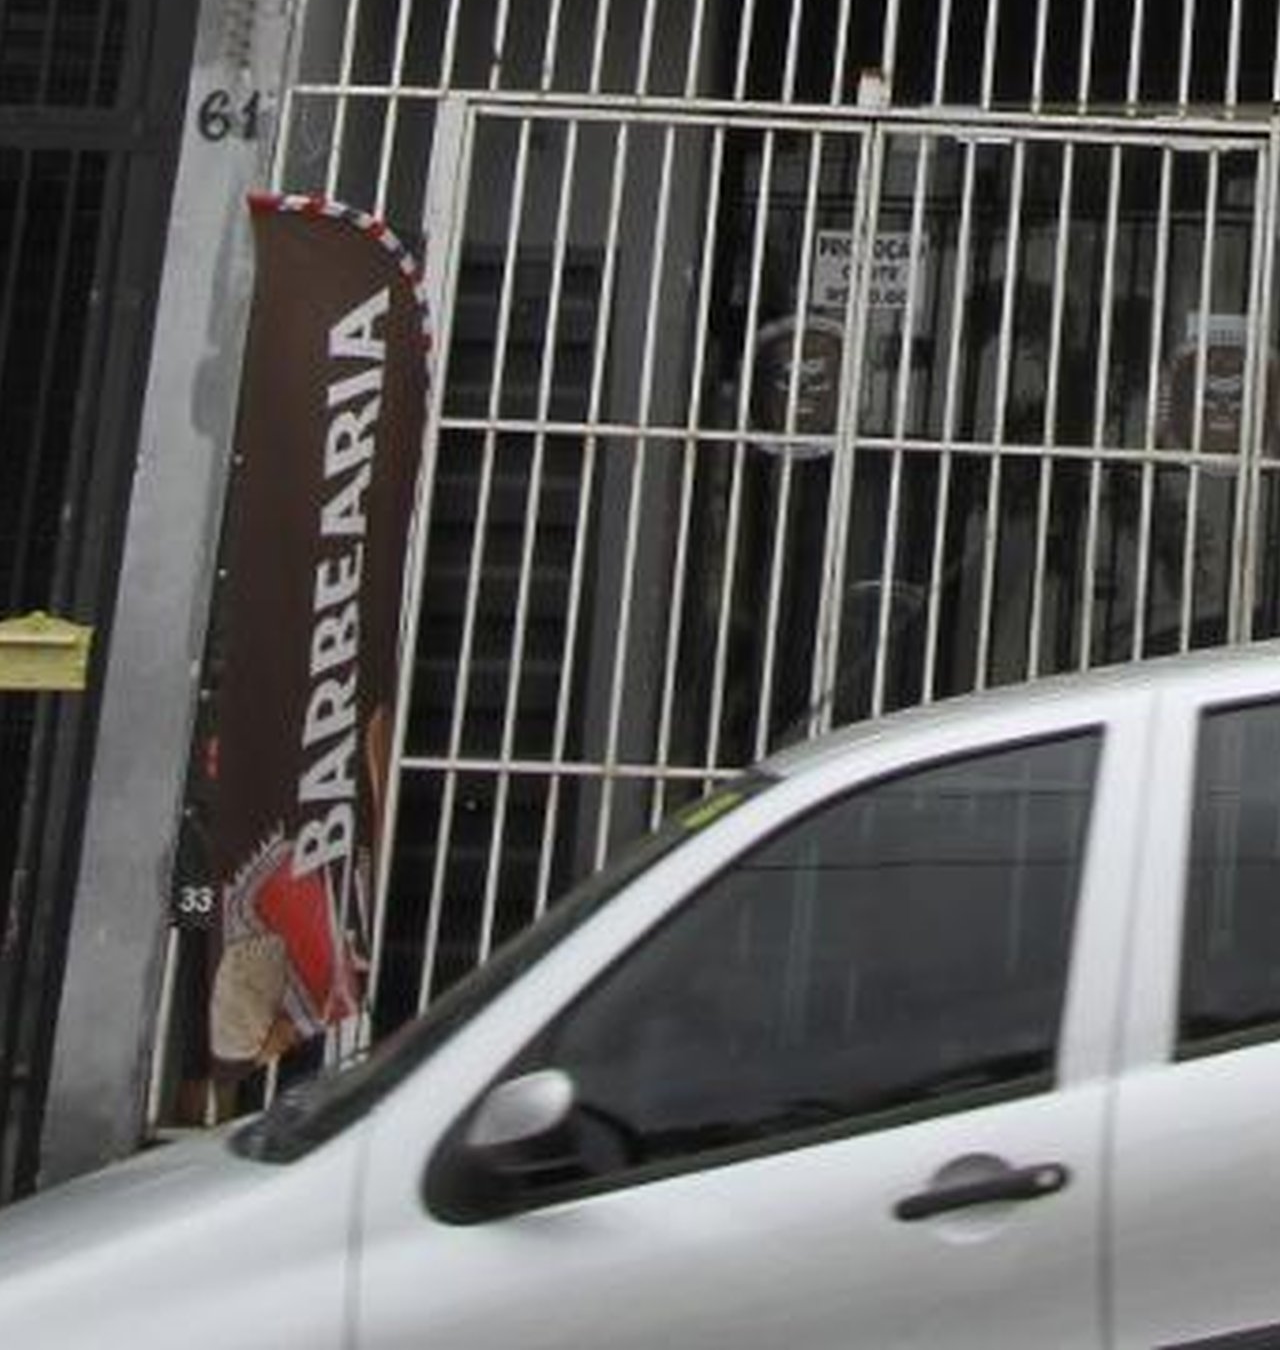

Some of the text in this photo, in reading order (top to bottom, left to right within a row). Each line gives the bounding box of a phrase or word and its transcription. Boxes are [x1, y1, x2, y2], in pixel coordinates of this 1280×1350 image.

[198, 89, 261, 141] 61
[841, 264, 897, 283] CRTE
[291, 286, 391, 880] BARBEARIA
